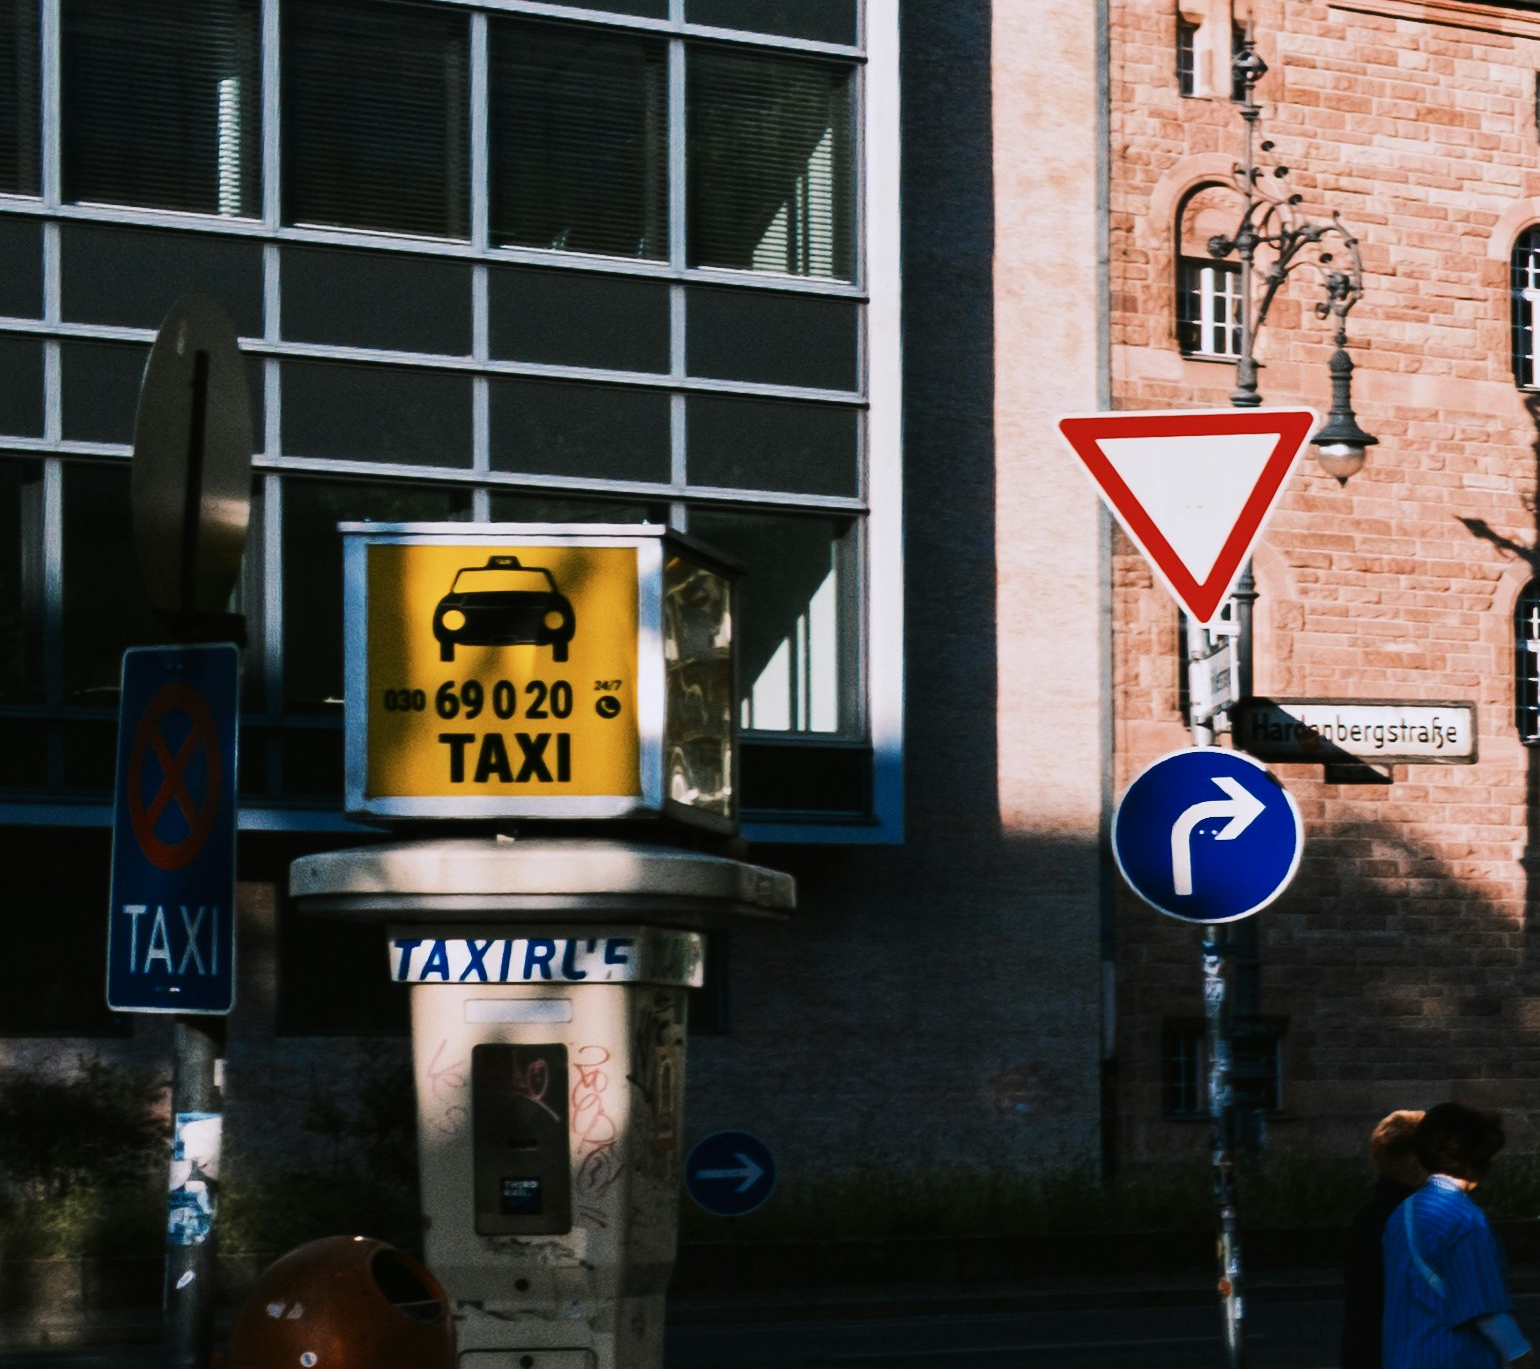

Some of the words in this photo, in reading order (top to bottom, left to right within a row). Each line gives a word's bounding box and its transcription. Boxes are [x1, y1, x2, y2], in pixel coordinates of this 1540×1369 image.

[384, 689, 426, 712] 030
[435, 679, 485, 720] 69
[493, 679, 517, 720] 0
[525, 679, 573, 720] 20
[1253, 712, 1458, 749] Hardenbergstraße
[438, 732, 572, 784] TAXI
[122, 904, 218, 976] TAXI
